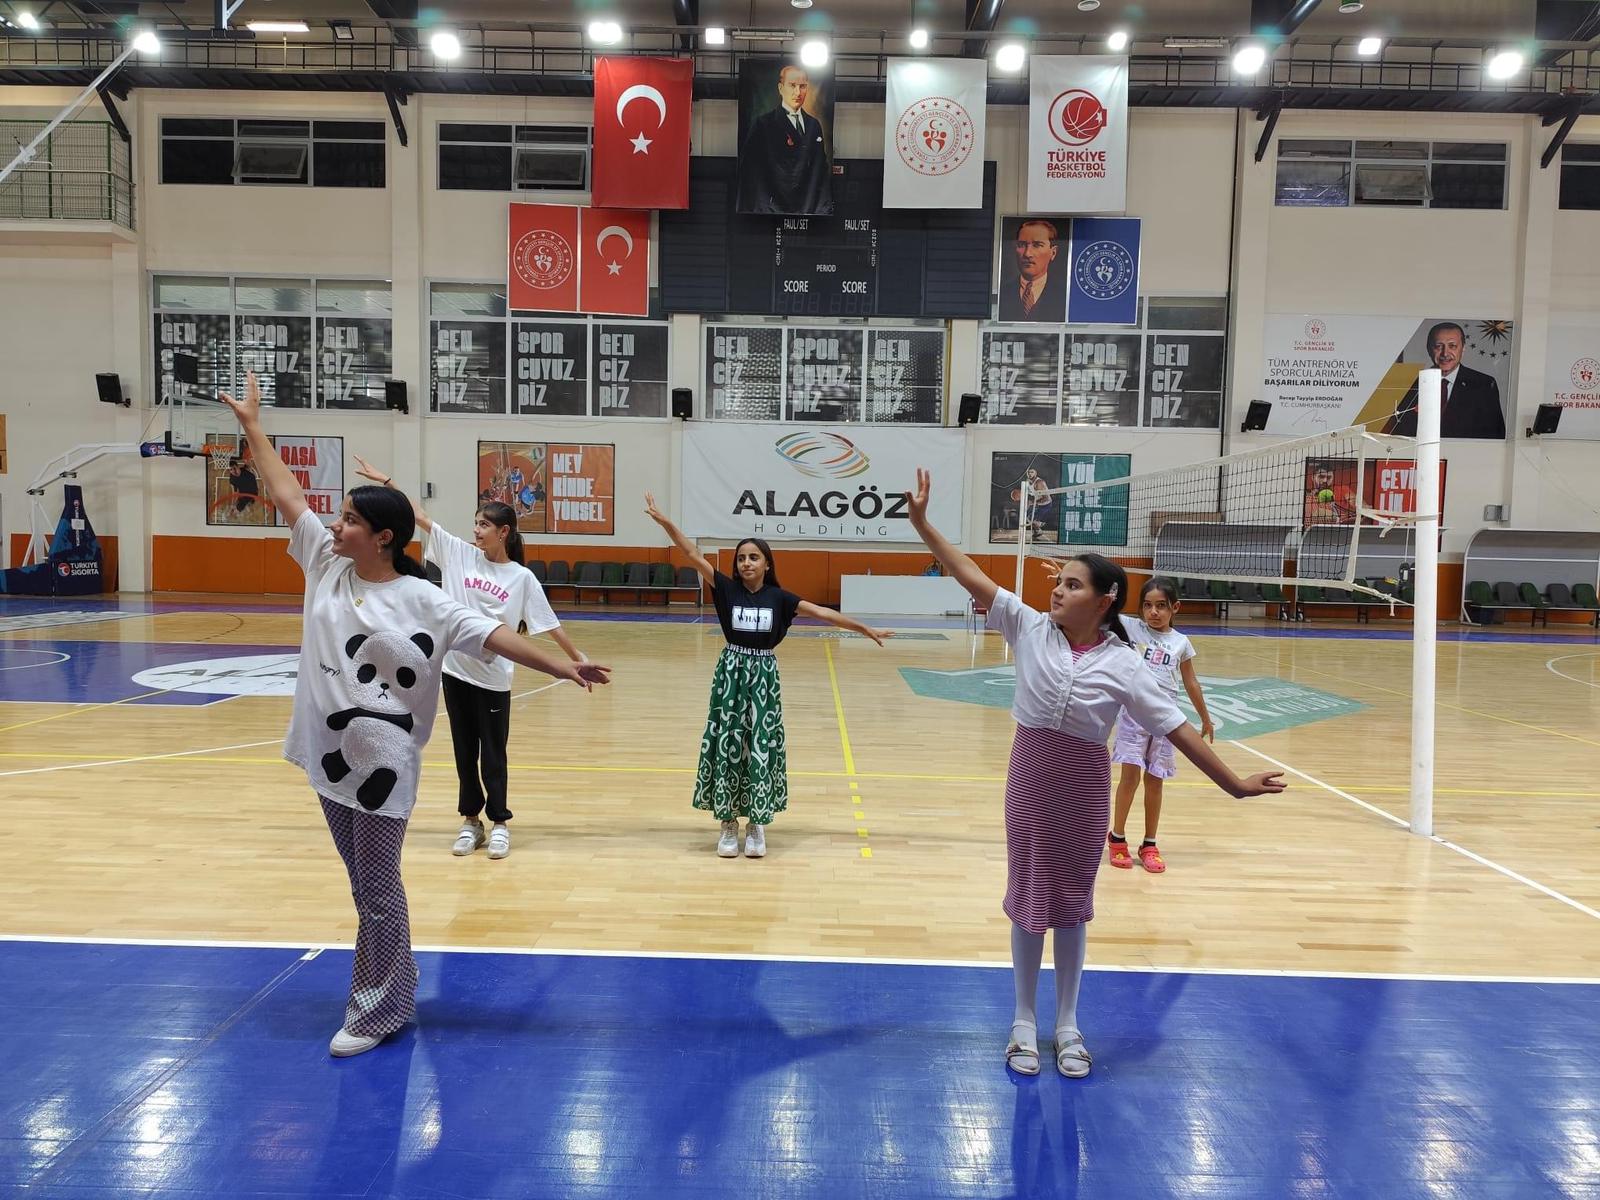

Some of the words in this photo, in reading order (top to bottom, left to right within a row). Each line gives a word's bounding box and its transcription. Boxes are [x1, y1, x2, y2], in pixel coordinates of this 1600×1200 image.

[1047, 148, 1106, 162] TÜRKİYE
[1047, 163, 1106, 171] BASKETBOL
[1047, 171, 1106, 179] FEDERASYONU
[784, 219, 809, 230] FAUL/SET
[844, 219, 870, 231] FAUL/SET
[816, 264, 837, 272] PERIOD
[783, 280, 809, 293] SCORE
[842, 281, 868, 294] SCORE
[161, 322, 197, 345] GEN
[242, 324, 288, 347] SPOR
[323, 326, 358, 349] GEN
[438, 329, 473, 352] GEN
[518, 331, 564, 355] SPOR
[600, 333, 635, 356] GEN
[714, 336, 749, 359] GEN
[793, 337, 839, 361] SPOR
[875, 339, 910, 362] GEN
[989, 341, 1025, 364] GEN
[1071, 342, 1118, 365] SPOR
[1153, 343, 1189, 366] GEN
[518, 358, 575, 381] CUYUZ
[600, 357, 630, 382] CİZ
[1267, 357, 1290, 368] TÜM
[1292, 358, 1345, 369] ANTRENÖR
[1346, 360, 1359, 369] VE
[1270, 368, 1355, 378] SPORCULARIMIZA
[792, 364, 850, 387] CUYUZ
[1070, 369, 1128, 392] CUYUZ
[1152, 368, 1184, 393] CİZ
[1264, 378, 1311, 387] BAŞARILAR
[1312, 379, 1360, 388] DİLİYORUM
[518, 381, 548, 407] BİZ
[600, 383, 630, 409] BİZ
[1554, 392, 1568, 400] T.C.
[1151, 394, 1183, 419] BİZ
[732, 485, 910, 520] ALAGÖZ
[754, 522, 887, 536] HOLDİNG
[464, 577, 509, 602] AMOUR
